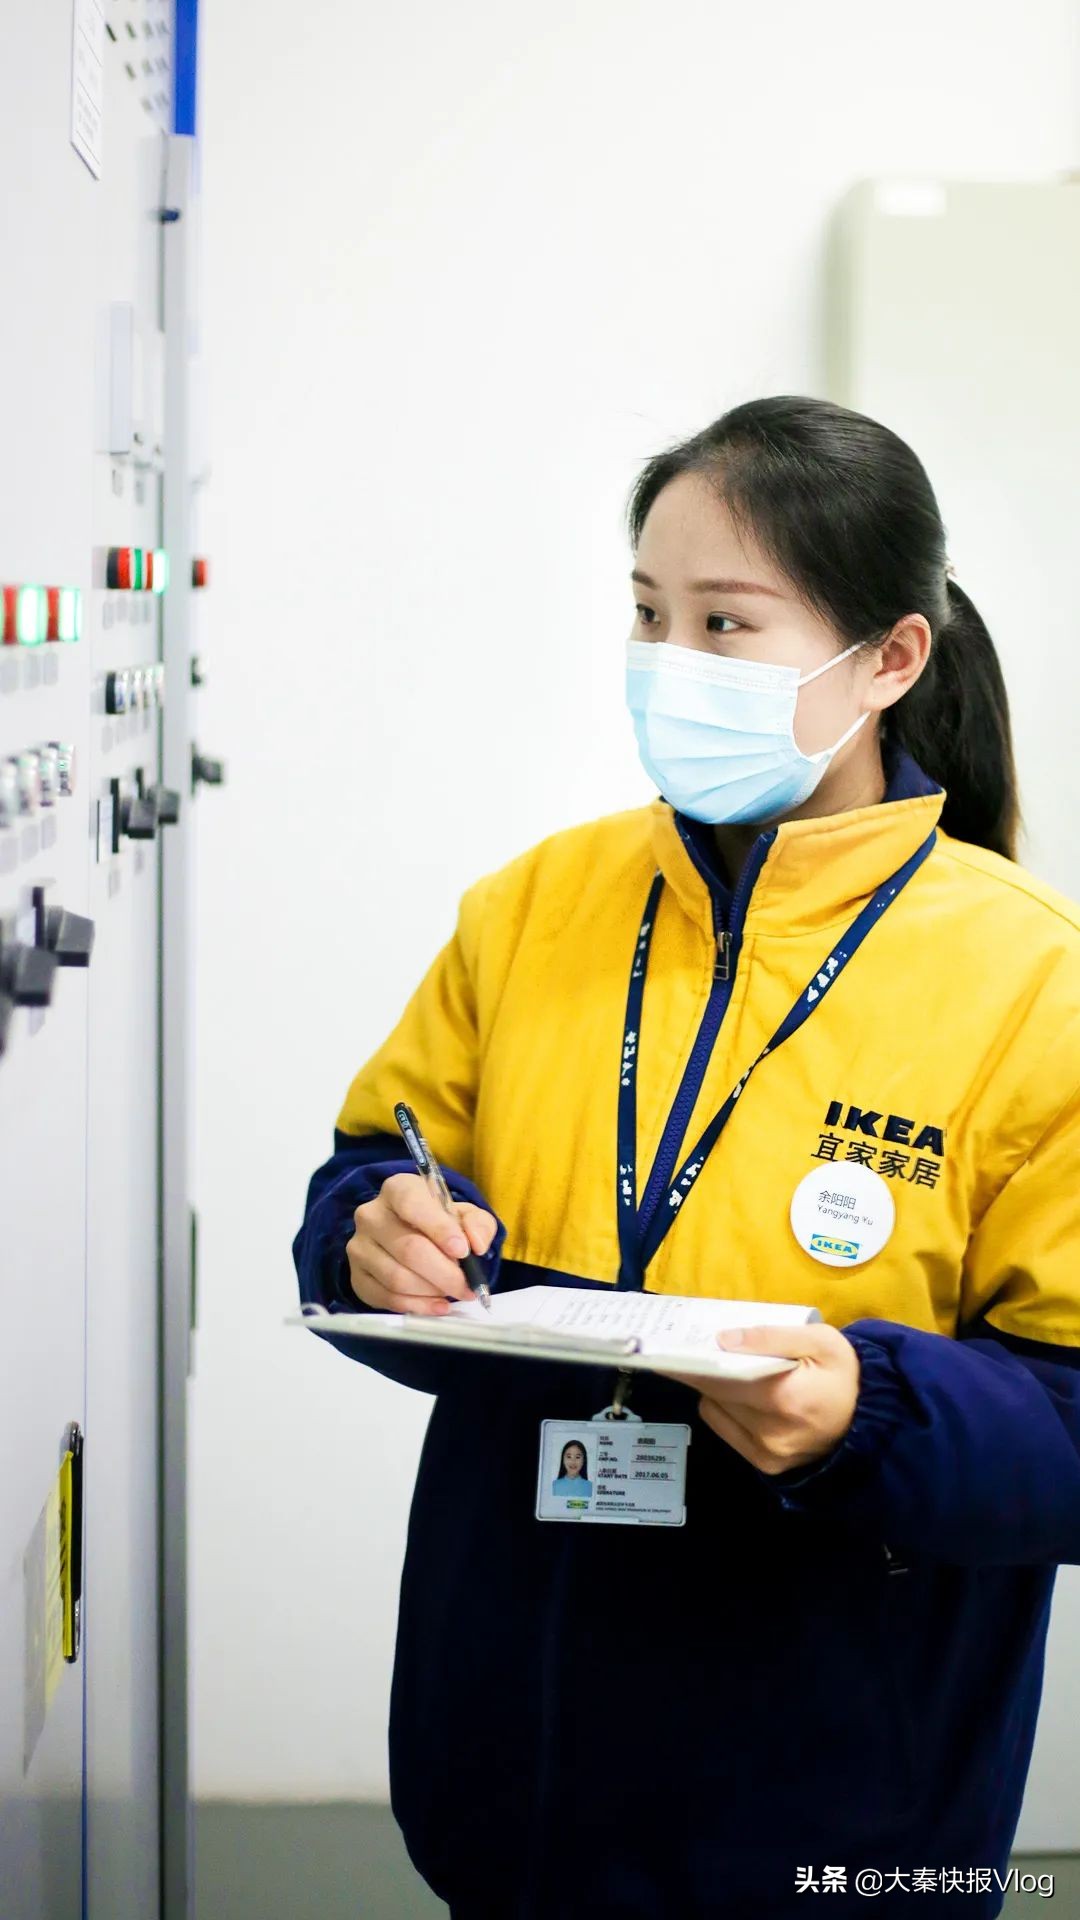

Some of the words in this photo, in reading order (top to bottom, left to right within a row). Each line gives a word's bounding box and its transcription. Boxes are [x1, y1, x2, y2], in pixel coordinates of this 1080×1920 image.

[824, 1101, 945, 1157] IKEA
[811, 1133, 941, 1189] 宜家家居
[818, 1190, 857, 1210] 余阳阳
[817, 1204, 860, 1225] Yangyang
[862, 1216, 874, 1226] Yu
[816, 1240, 853, 1253] IKEA
